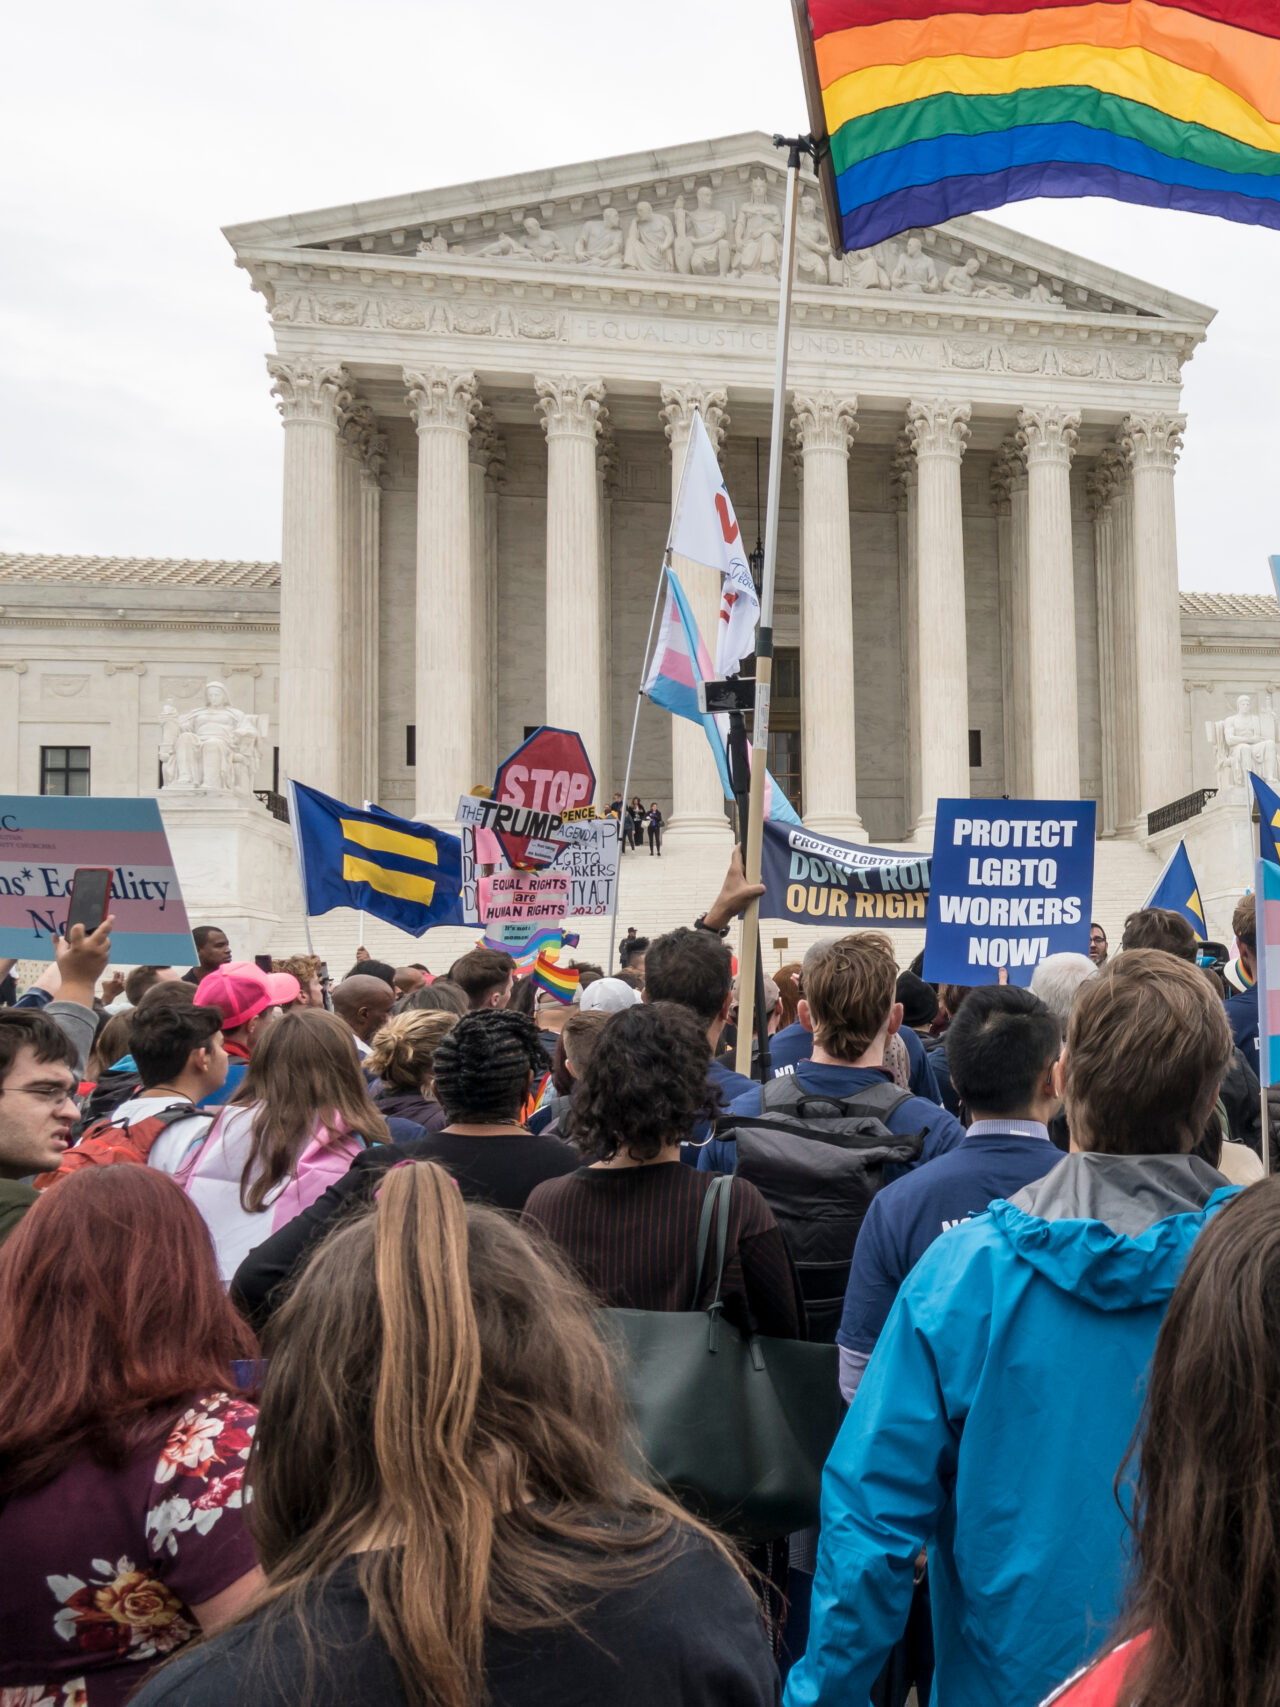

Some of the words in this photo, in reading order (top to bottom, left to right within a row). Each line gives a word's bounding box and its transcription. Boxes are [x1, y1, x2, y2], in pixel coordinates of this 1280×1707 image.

[587, 320, 673, 343] EQUAL
[680, 325, 776, 350] JUSTICE
[790, 333, 873, 357] UNDER
[880, 341, 924, 360] LAW
[501, 764, 590, 815] STOP
[461, 804, 482, 822] THE
[479, 800, 563, 840] TRUMP
[562, 807, 596, 821] PENCE
[557, 825, 598, 843] AGENDA
[792, 833, 850, 860] PROTECT
[953, 818, 1078, 848] PROTECT
[492, 878, 524, 891] EQUAL
[528, 878, 568, 891] RIGHTS
[788, 850, 872, 890] DON'T
[968, 857, 1058, 889] LGBTQ
[514, 893, 537, 903] are
[590, 878, 614, 906] ACT
[786, 883, 849, 917] OUR
[486, 905, 523, 919] HUMAN
[526, 903, 566, 916] RIGHTS
[570, 905, 607, 915] 2020!
[939, 895, 1082, 927] WORKERS
[968, 937, 1049, 968] NOW!
